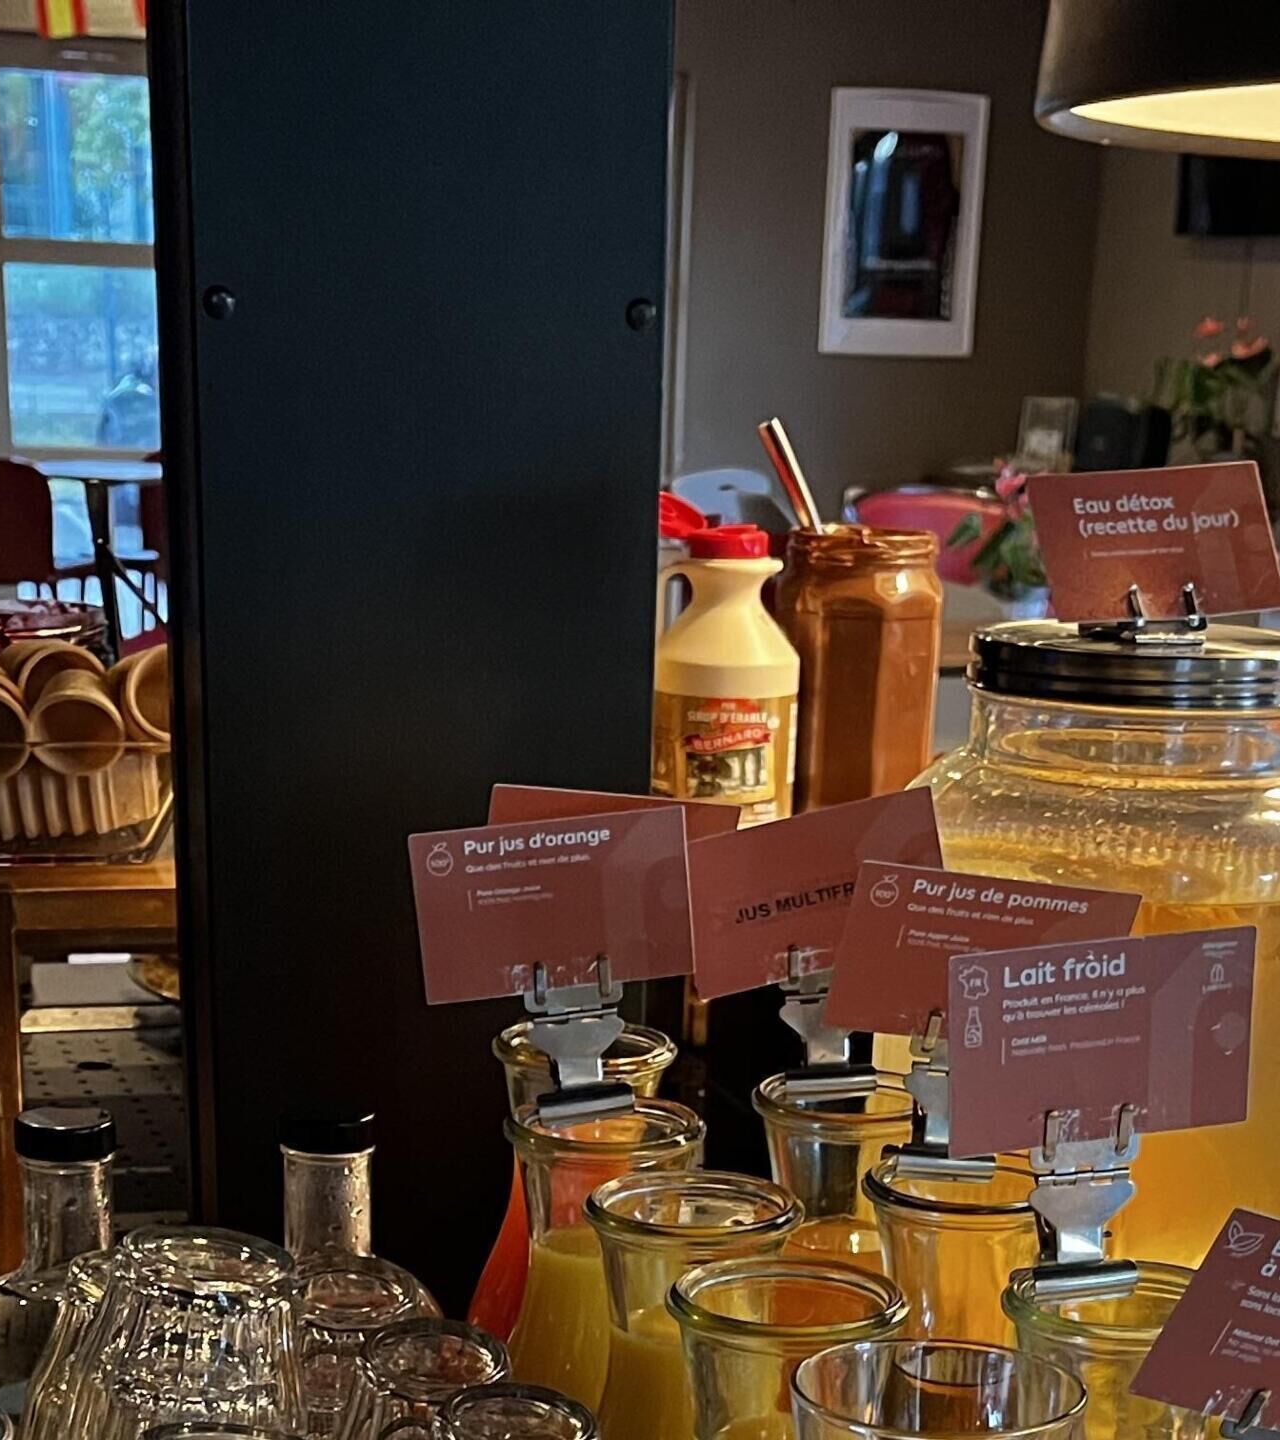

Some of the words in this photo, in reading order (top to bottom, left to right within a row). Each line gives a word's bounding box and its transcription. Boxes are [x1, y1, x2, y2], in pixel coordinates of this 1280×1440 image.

[1072, 497, 1111, 514] Eau
[1115, 493, 1175, 512] détox
[1078, 517, 1158, 538] (recette
[1162, 514, 1188, 531] du
[1191, 509, 1240, 533] jour)
[464, 840, 494, 856] Pur
[498, 836, 524, 856] jus
[529, 828, 611, 849] d'orange
[913, 878, 947, 897] Pur
[946, 882, 976, 902] jus
[980, 888, 1003, 904] de
[1007, 893, 1089, 914] pommes
[736, 903, 771, 924] JUS
[907, 902, 926, 913] Que
[927, 904, 945, 915] des
[946, 906, 970, 919] fruits
[1003, 960, 1056, 988] Lait
[1002, 994, 1038, 1009] Produit
[1040, 995, 1054, 1005] en
[1116, 988, 1124, 997] a
[1125, 984, 1146, 998] plus
[1026, 1007, 1062, 1020] trouver
[1063, 1004, 1077, 1015] les
[1260, 1259, 1276, 1278] à
[1246, 1285, 1271, 1300] Sans
[1240, 1298, 1262, 1312] sans
